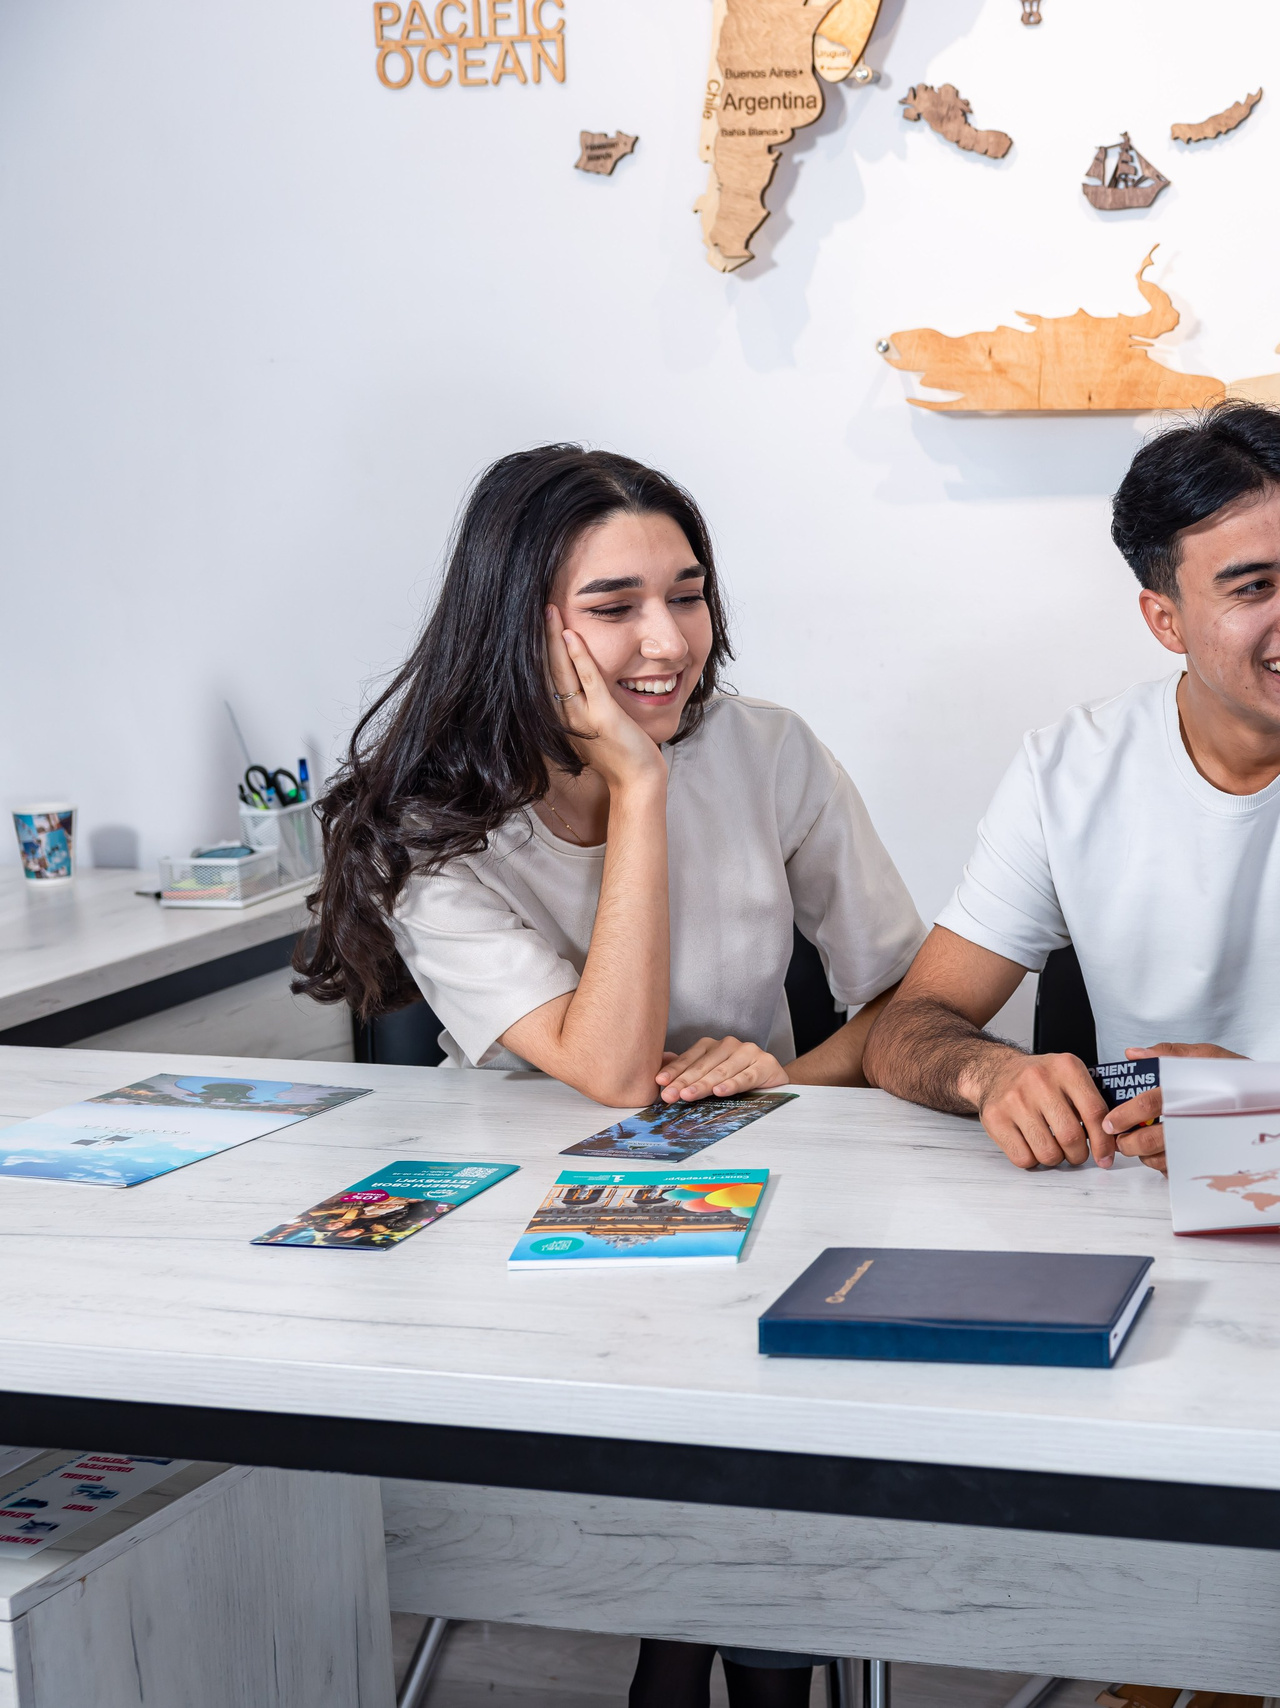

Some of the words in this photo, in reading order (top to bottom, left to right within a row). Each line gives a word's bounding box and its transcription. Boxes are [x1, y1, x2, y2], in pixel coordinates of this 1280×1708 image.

[374, 0, 565, 47] PACIFIC
[375, 34, 566, 90] OCEAN
[724, 69, 766, 79] Buenos
[768, 67, 798, 78] Aires
[702, 79, 721, 120] Chile
[722, 93, 817, 115] Argentina
[1102, 1072, 1157, 1090] FINANS
